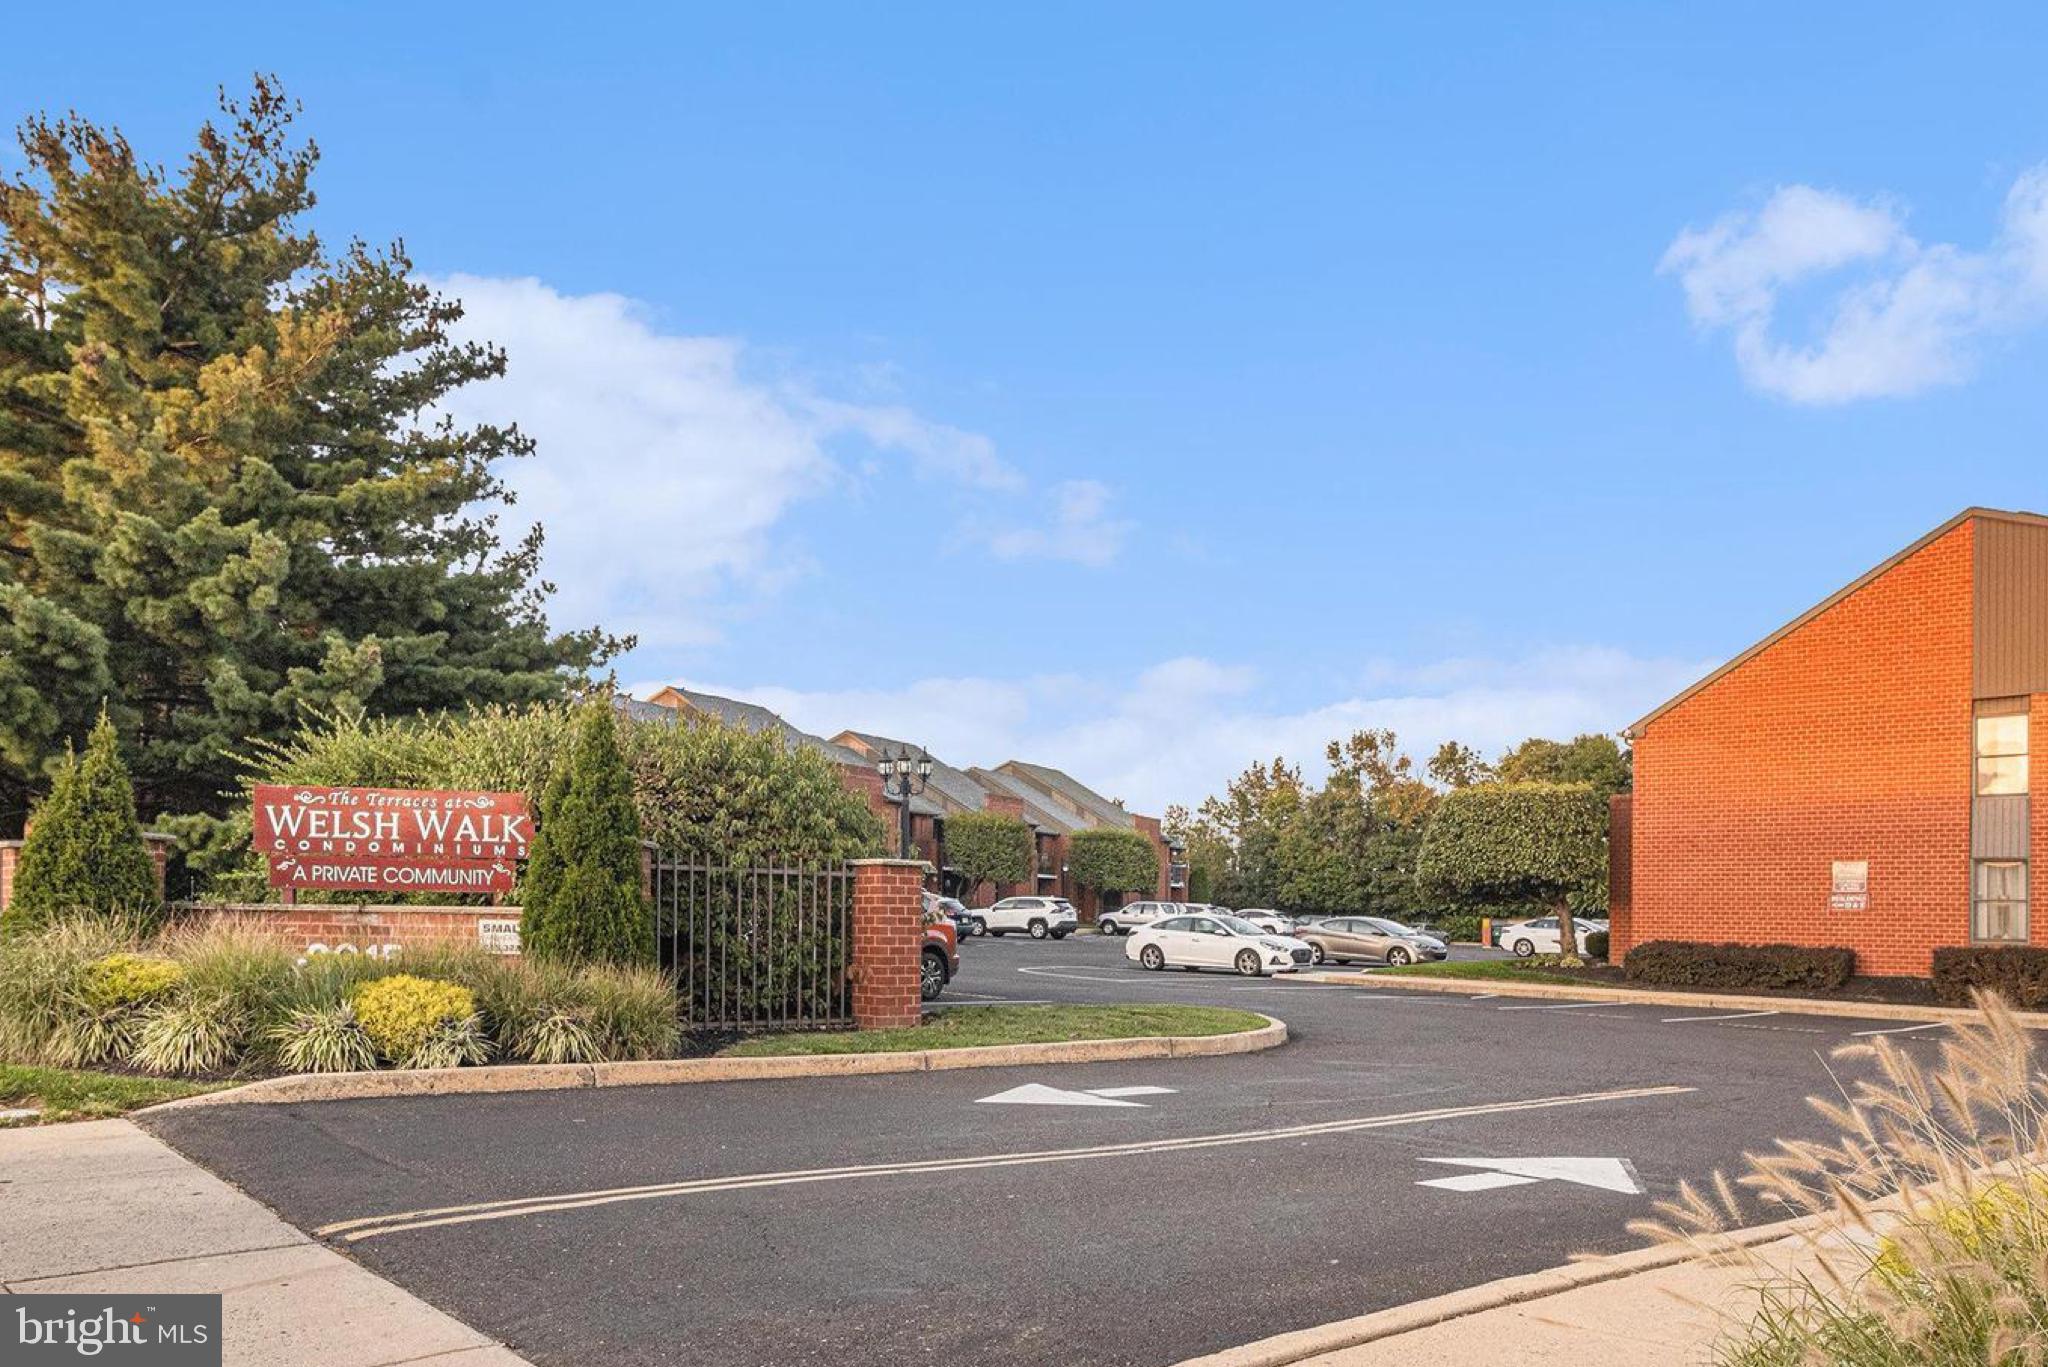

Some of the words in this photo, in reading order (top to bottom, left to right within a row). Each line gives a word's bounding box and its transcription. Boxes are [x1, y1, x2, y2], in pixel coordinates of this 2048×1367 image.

[329, 791, 358, 806] The
[366, 793, 437, 808] Terraces
[445, 797, 462, 808] at
[265, 805, 400, 839] WELSH
[413, 810, 526, 843] WALK
[274, 840, 526, 856] CONDOMINIUMS
[292, 865, 307, 881] A
[312, 865, 378, 882] PRIVATE
[383, 867, 494, 885] COMMUNITY
